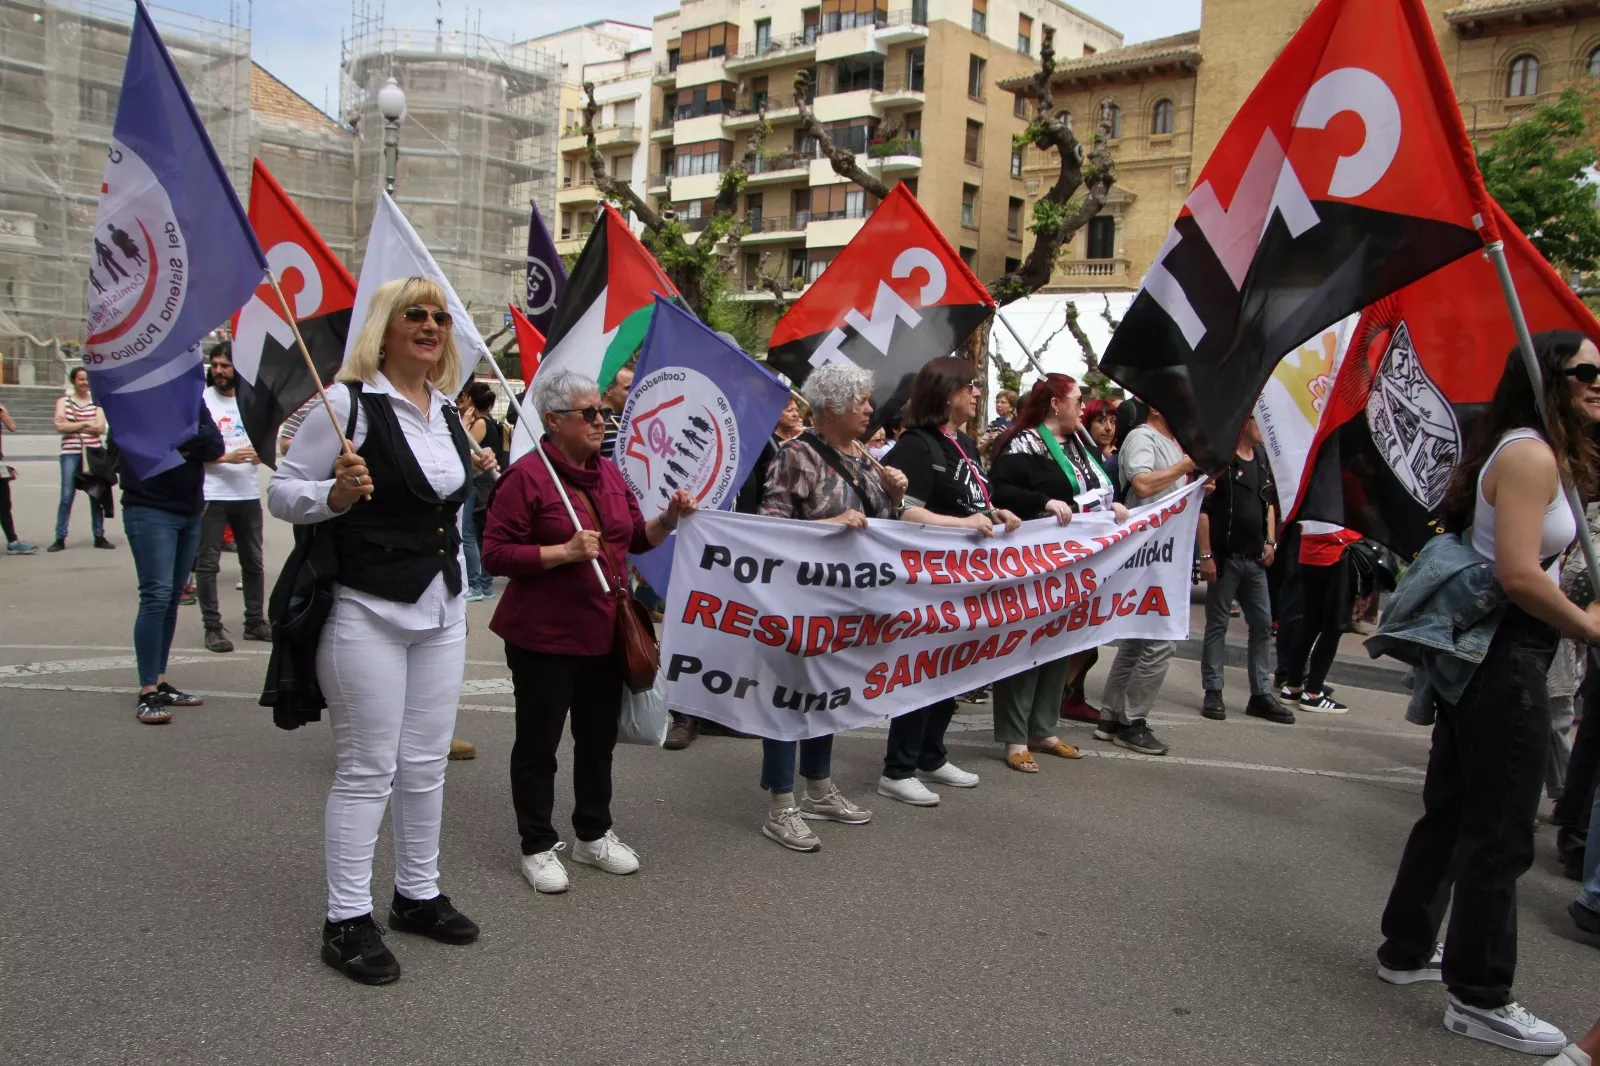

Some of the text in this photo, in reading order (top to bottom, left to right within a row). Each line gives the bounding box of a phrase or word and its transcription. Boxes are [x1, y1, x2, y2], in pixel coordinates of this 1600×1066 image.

[1266, 424, 1283, 457] Aragón
[699, 539, 1094, 589] Por unas PENSIONES
[681, 590, 961, 658] RESIDENCIAS
[963, 568, 1097, 632] PÚBLICAS
[667, 653, 759, 699] Por
[772, 685, 851, 714] una
[862, 629, 1027, 700] SANIDAD
